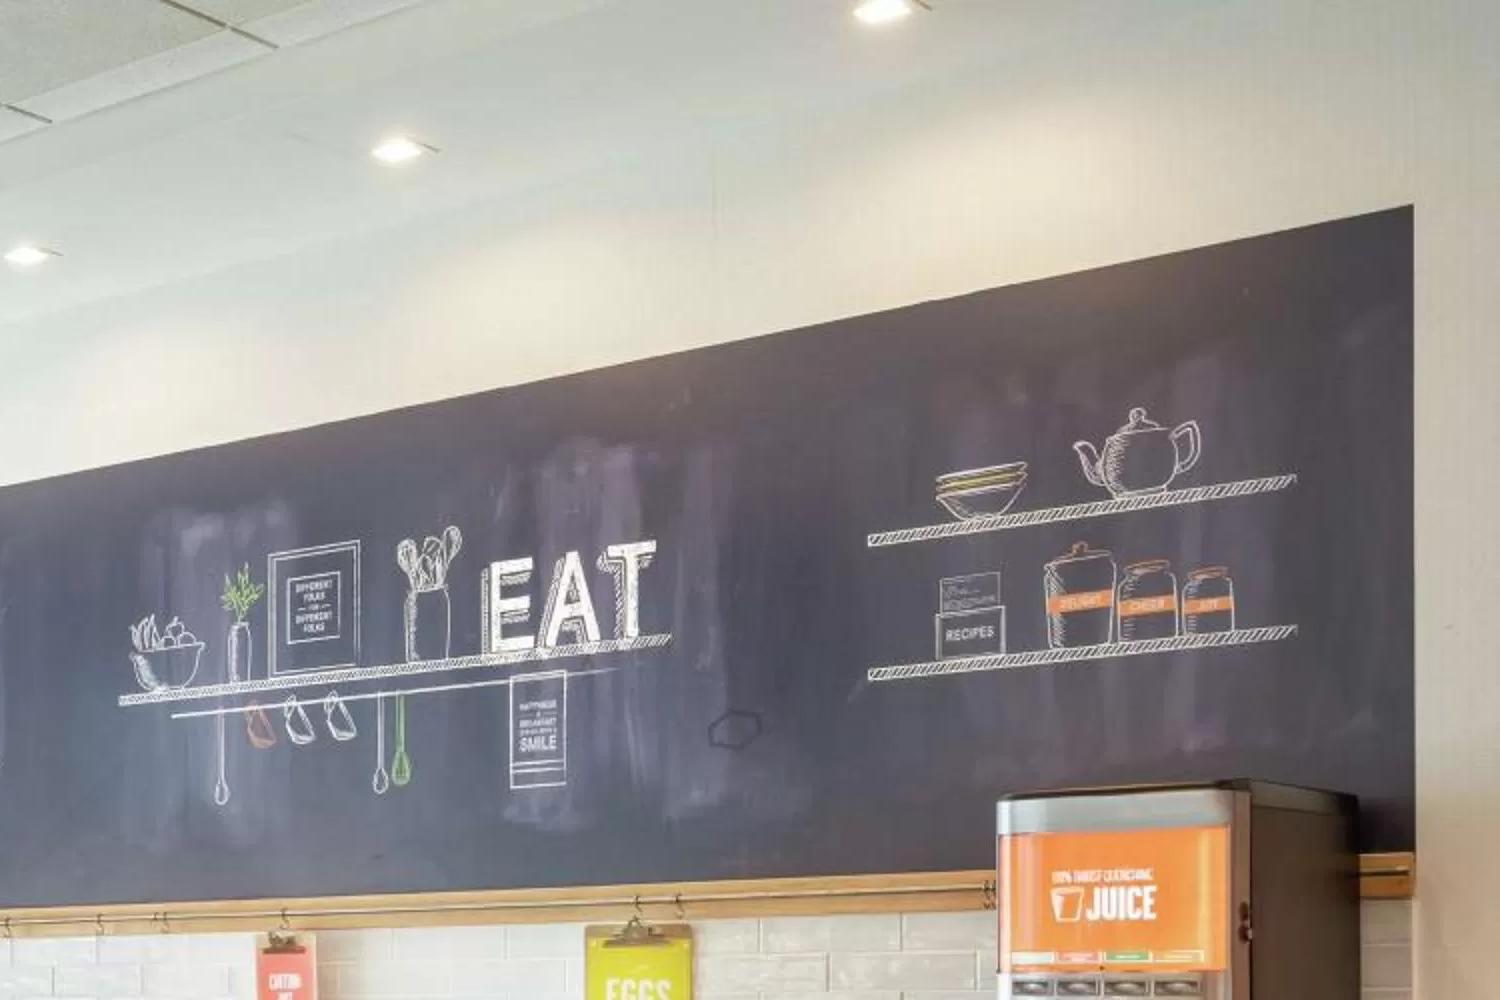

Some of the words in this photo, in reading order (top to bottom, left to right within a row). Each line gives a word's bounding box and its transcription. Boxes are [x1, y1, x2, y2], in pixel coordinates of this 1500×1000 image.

[482, 540, 657, 654] EAT
[945, 625, 995, 641] RECIPES
[519, 735, 557, 752] SMILE
[1086, 885, 1157, 921] JUICE
